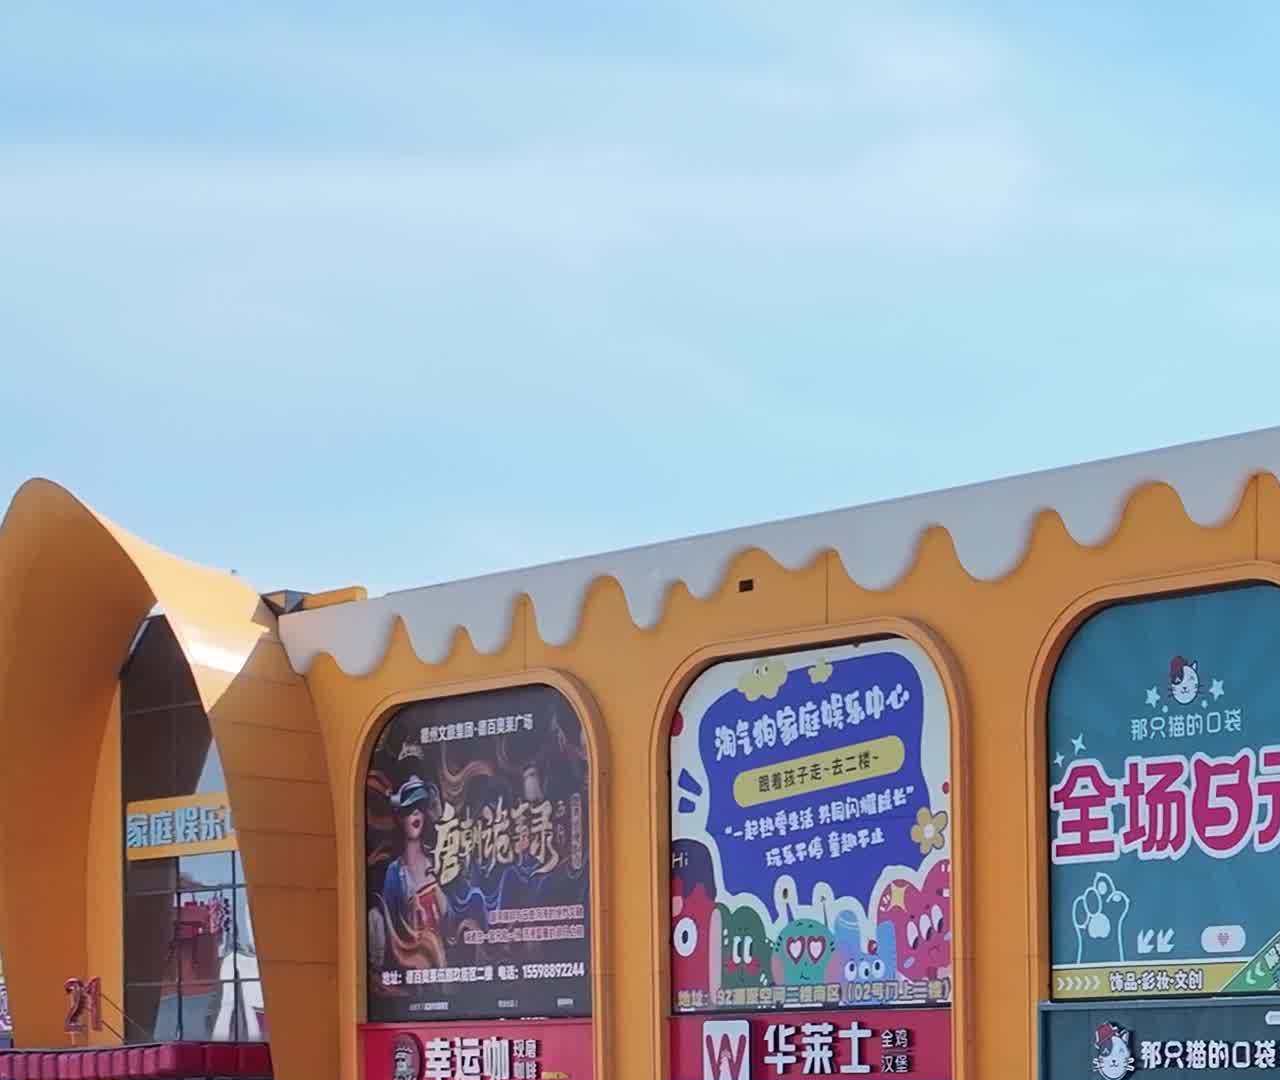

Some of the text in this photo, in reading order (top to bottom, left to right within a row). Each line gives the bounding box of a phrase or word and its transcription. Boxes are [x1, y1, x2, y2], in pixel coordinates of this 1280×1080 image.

[1130, 708, 1242, 741] 那只猫的口袋
[763, 1021, 873, 1075] 华莱士
[880, 1029, 910, 1049] 全鸡
[880, 1055, 910, 1073] 汉堡
[1140, 1040, 1277, 1069] 那只猫的口袋
